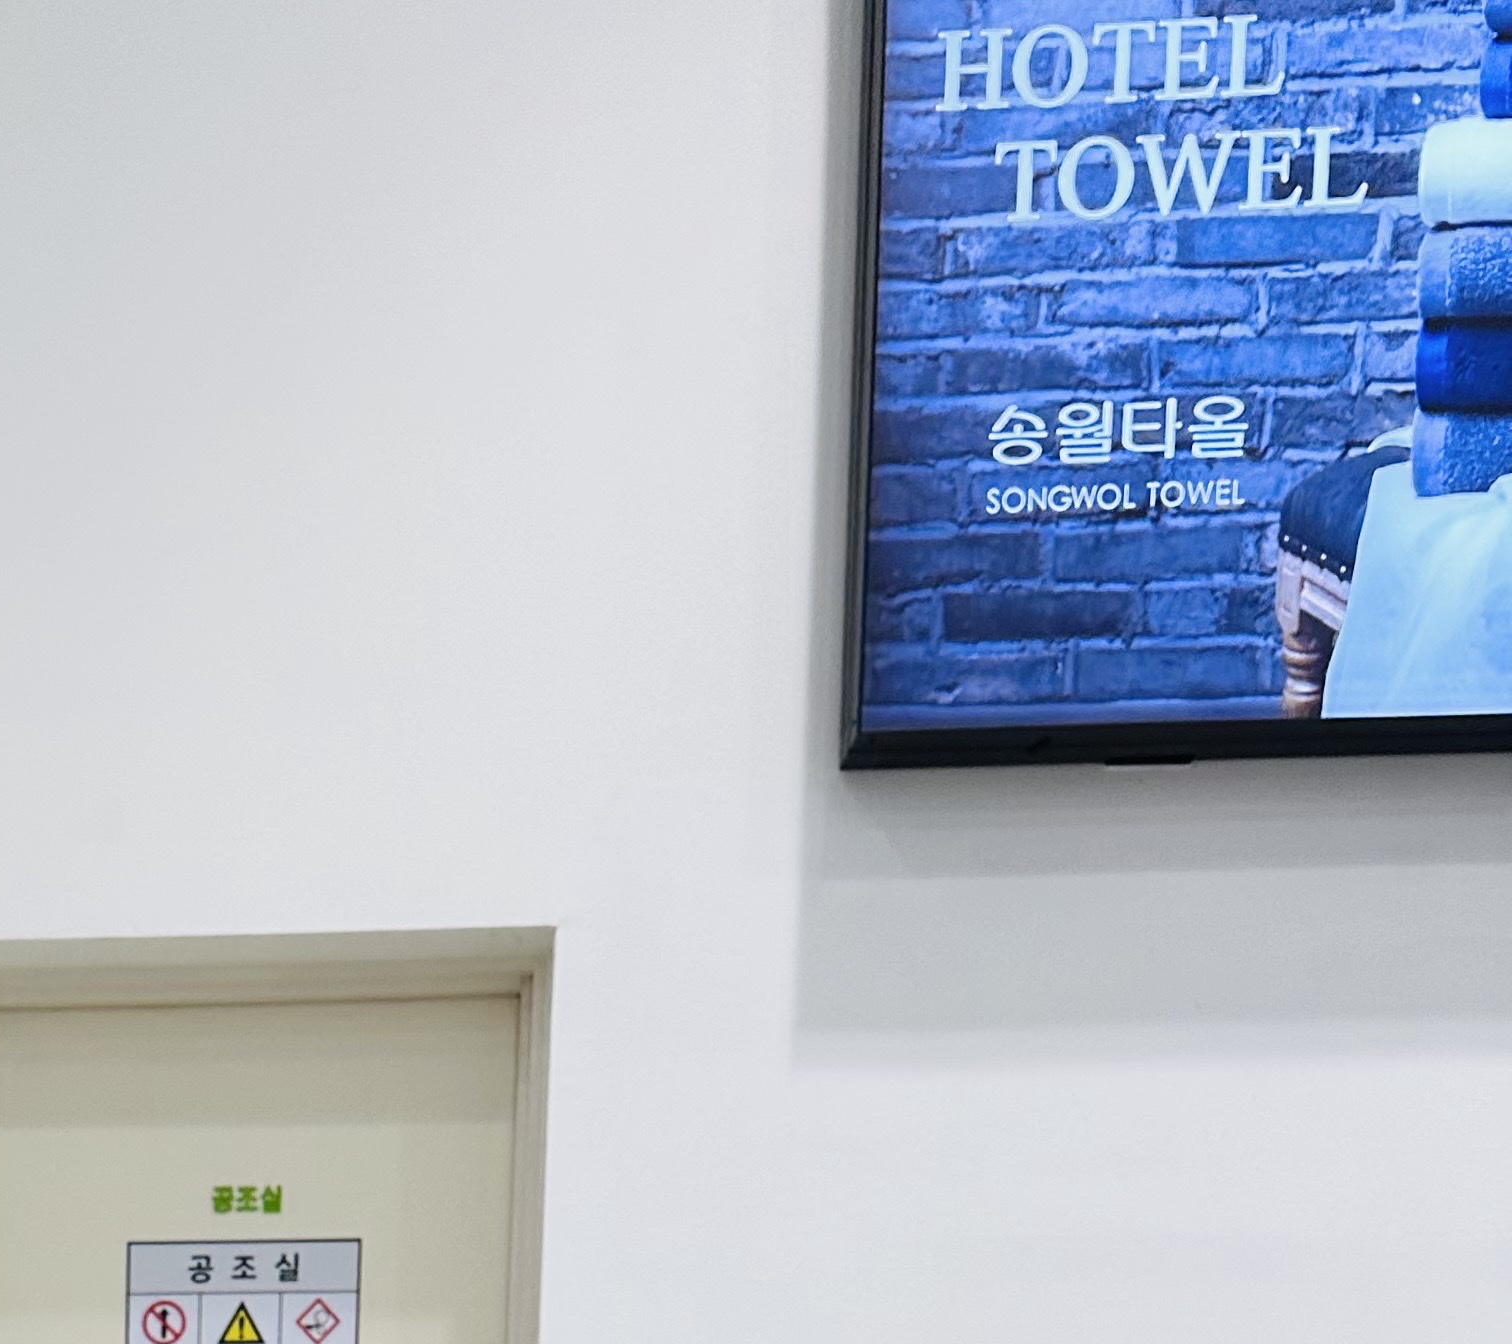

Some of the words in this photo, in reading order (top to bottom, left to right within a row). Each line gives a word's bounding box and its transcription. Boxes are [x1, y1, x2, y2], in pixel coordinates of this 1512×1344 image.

[935, 14, 1286, 112] HOTEL
[995, 127, 1368, 223] TOWEL
[988, 395, 1250, 466] 송월타올
[985, 483, 1137, 515] SONGWOL
[1145, 479, 1246, 508] TOWEL
[212, 1185, 283, 1214] 공조실
